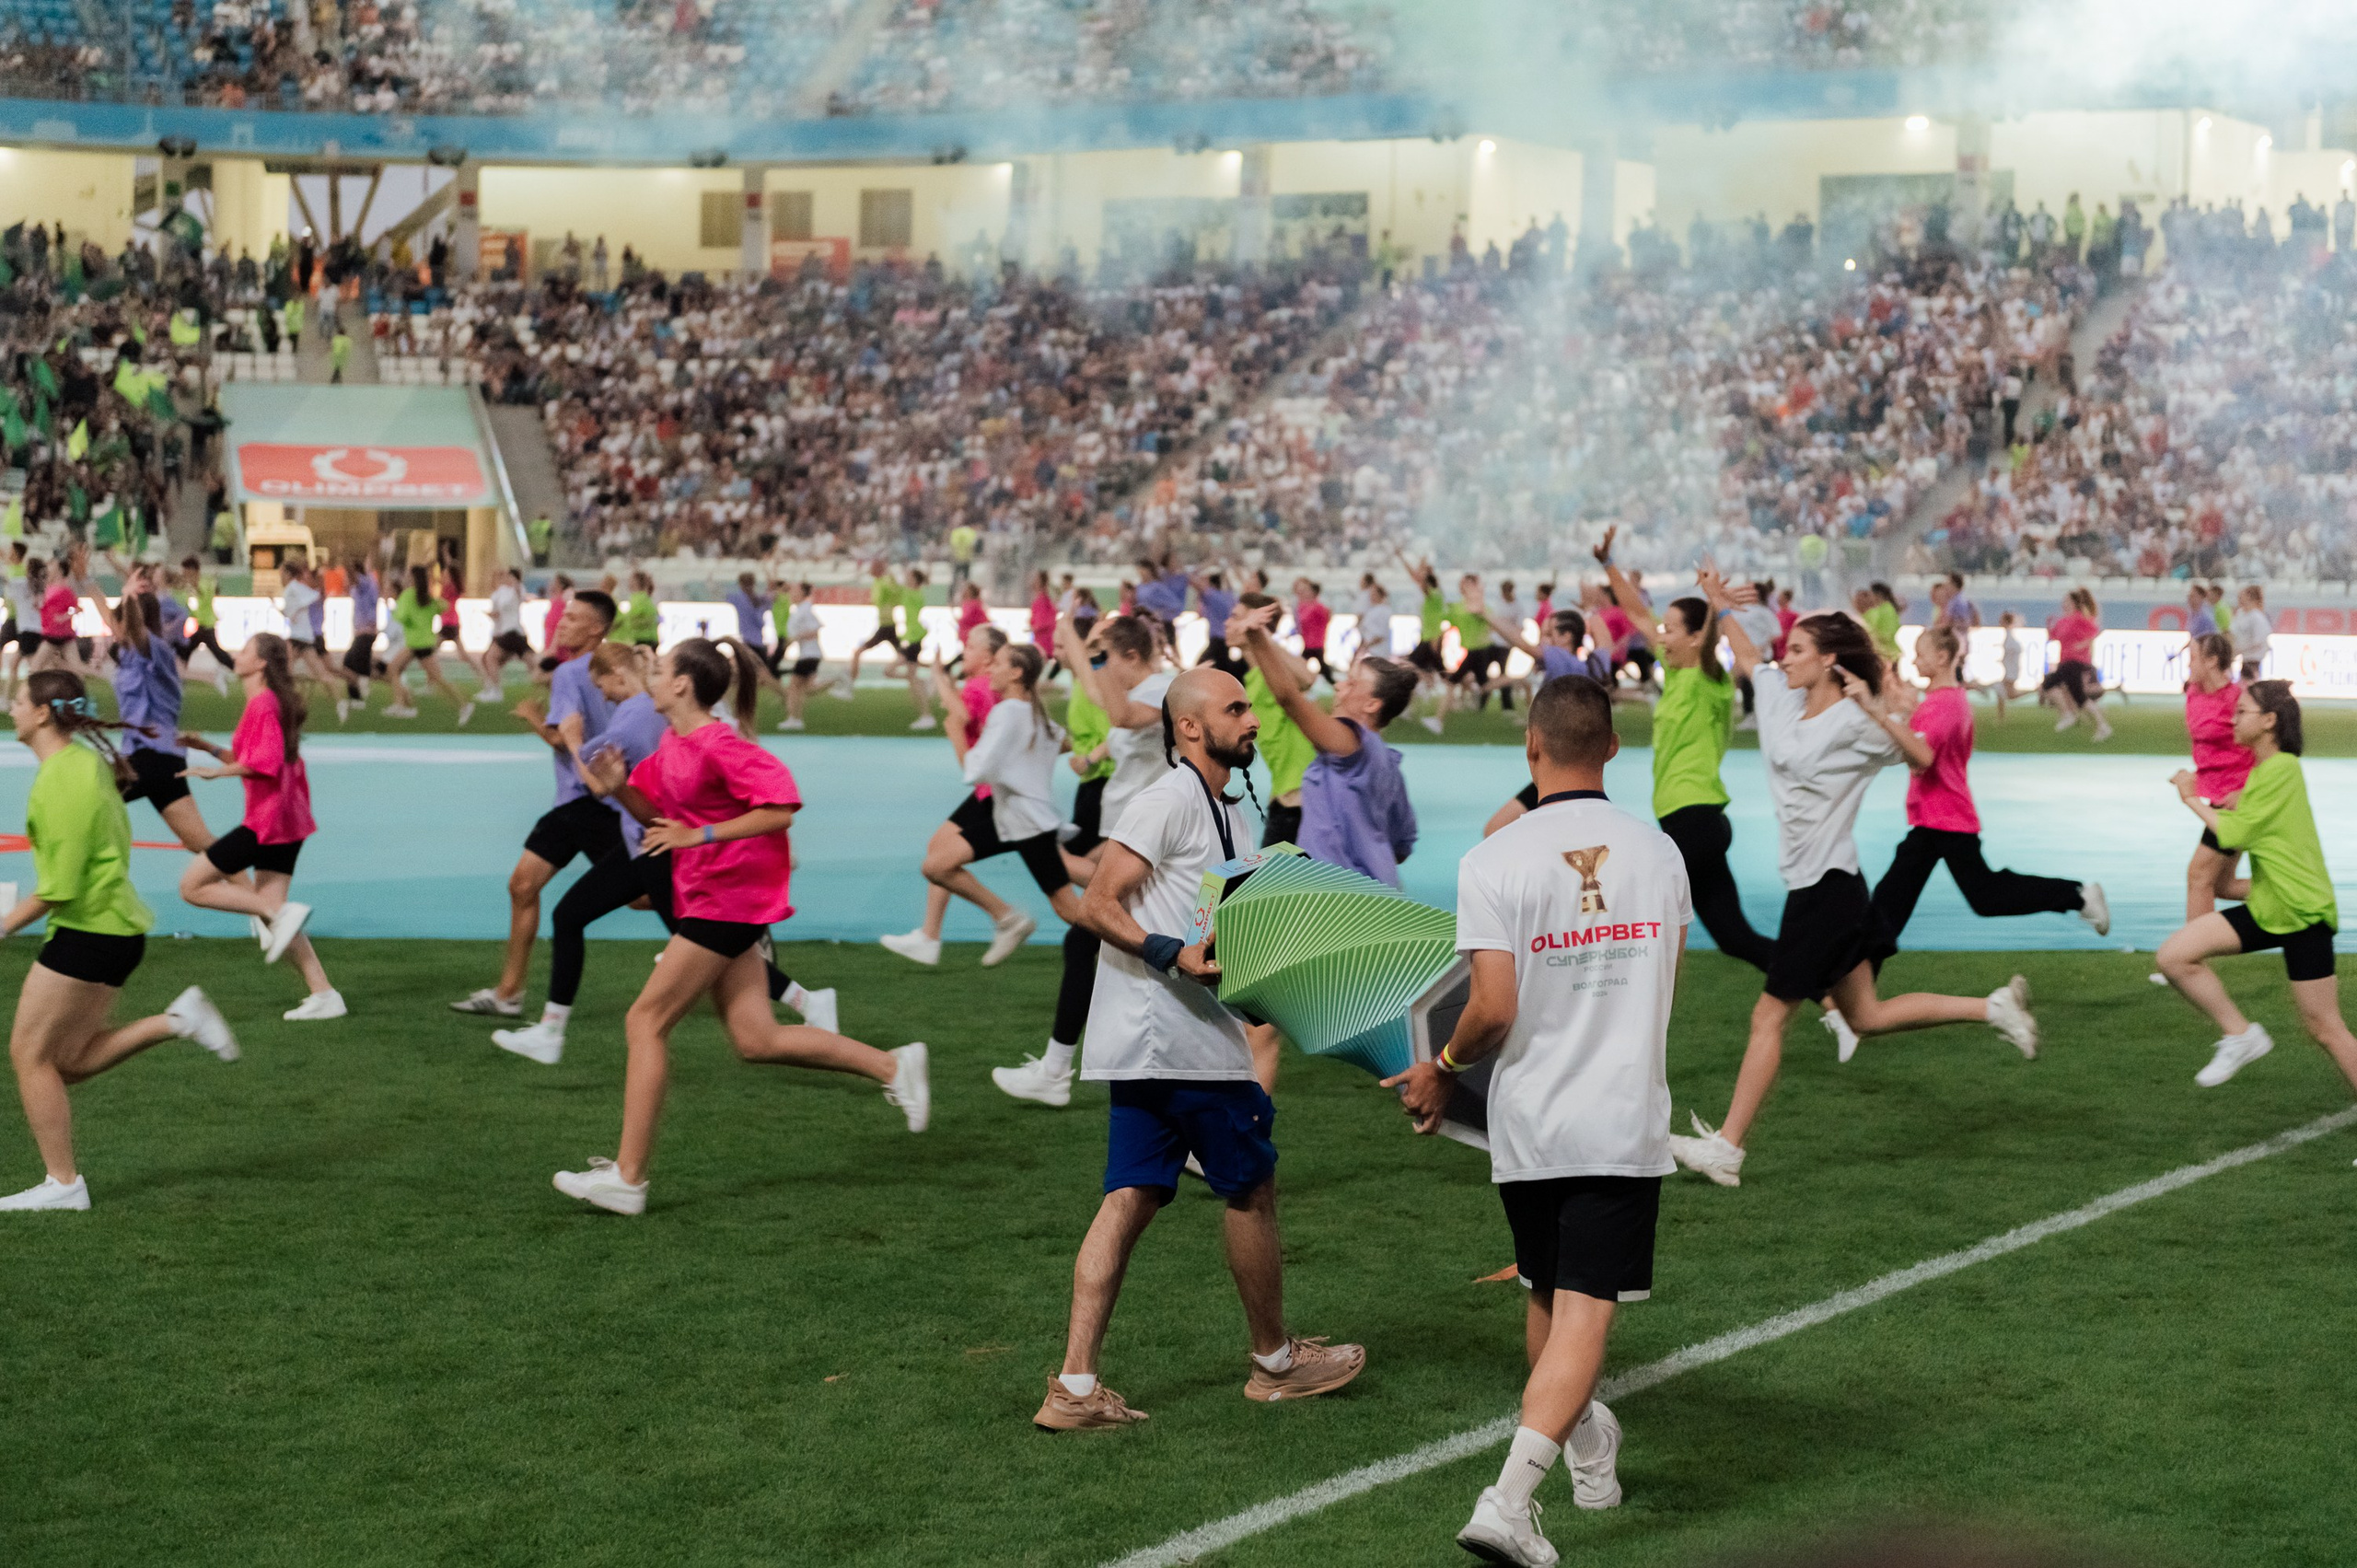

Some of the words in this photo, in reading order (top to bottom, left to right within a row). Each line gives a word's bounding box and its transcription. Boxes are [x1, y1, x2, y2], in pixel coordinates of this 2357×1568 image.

[1200, 893, 1214, 942] LIMPBET
[1530, 922, 1661, 953] OLIMPBET
[1546, 946, 1648, 967] СУПЕРКУБОК
[1573, 977, 1629, 992] ВОЛГОГРАД
